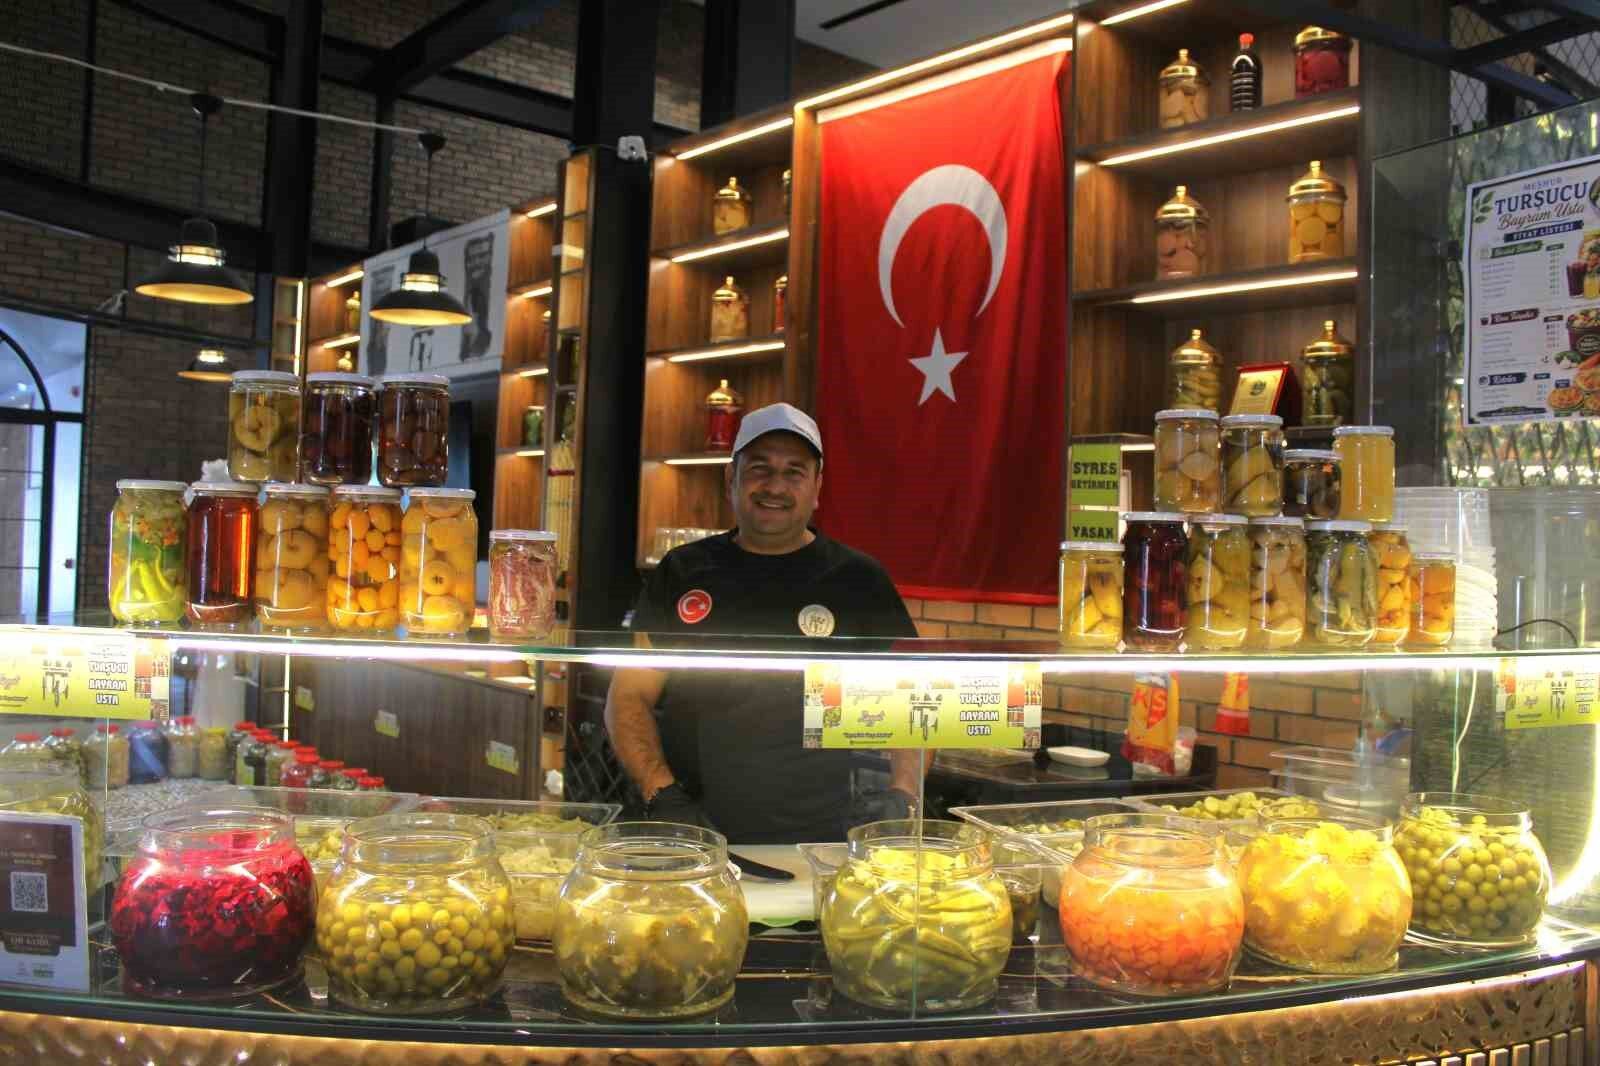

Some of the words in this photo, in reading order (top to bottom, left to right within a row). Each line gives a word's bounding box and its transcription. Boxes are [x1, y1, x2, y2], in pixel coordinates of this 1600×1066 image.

[1495, 182, 1588, 215] TURŞUCU
[1497, 210, 1551, 230] Bayram
[1553, 202, 1585, 218] Usta
[1073, 462, 1117, 475] STRES
[1072, 526, 1114, 539] YASAK
[88, 660, 129, 676] TURŞUCU
[88, 679, 128, 692] BAYRAM
[95, 693, 119, 706] USTA
[960, 692, 1001, 707] TURŞUCU
[960, 710, 1000, 722] BAYRAM
[967, 724, 992, 737] USTA
